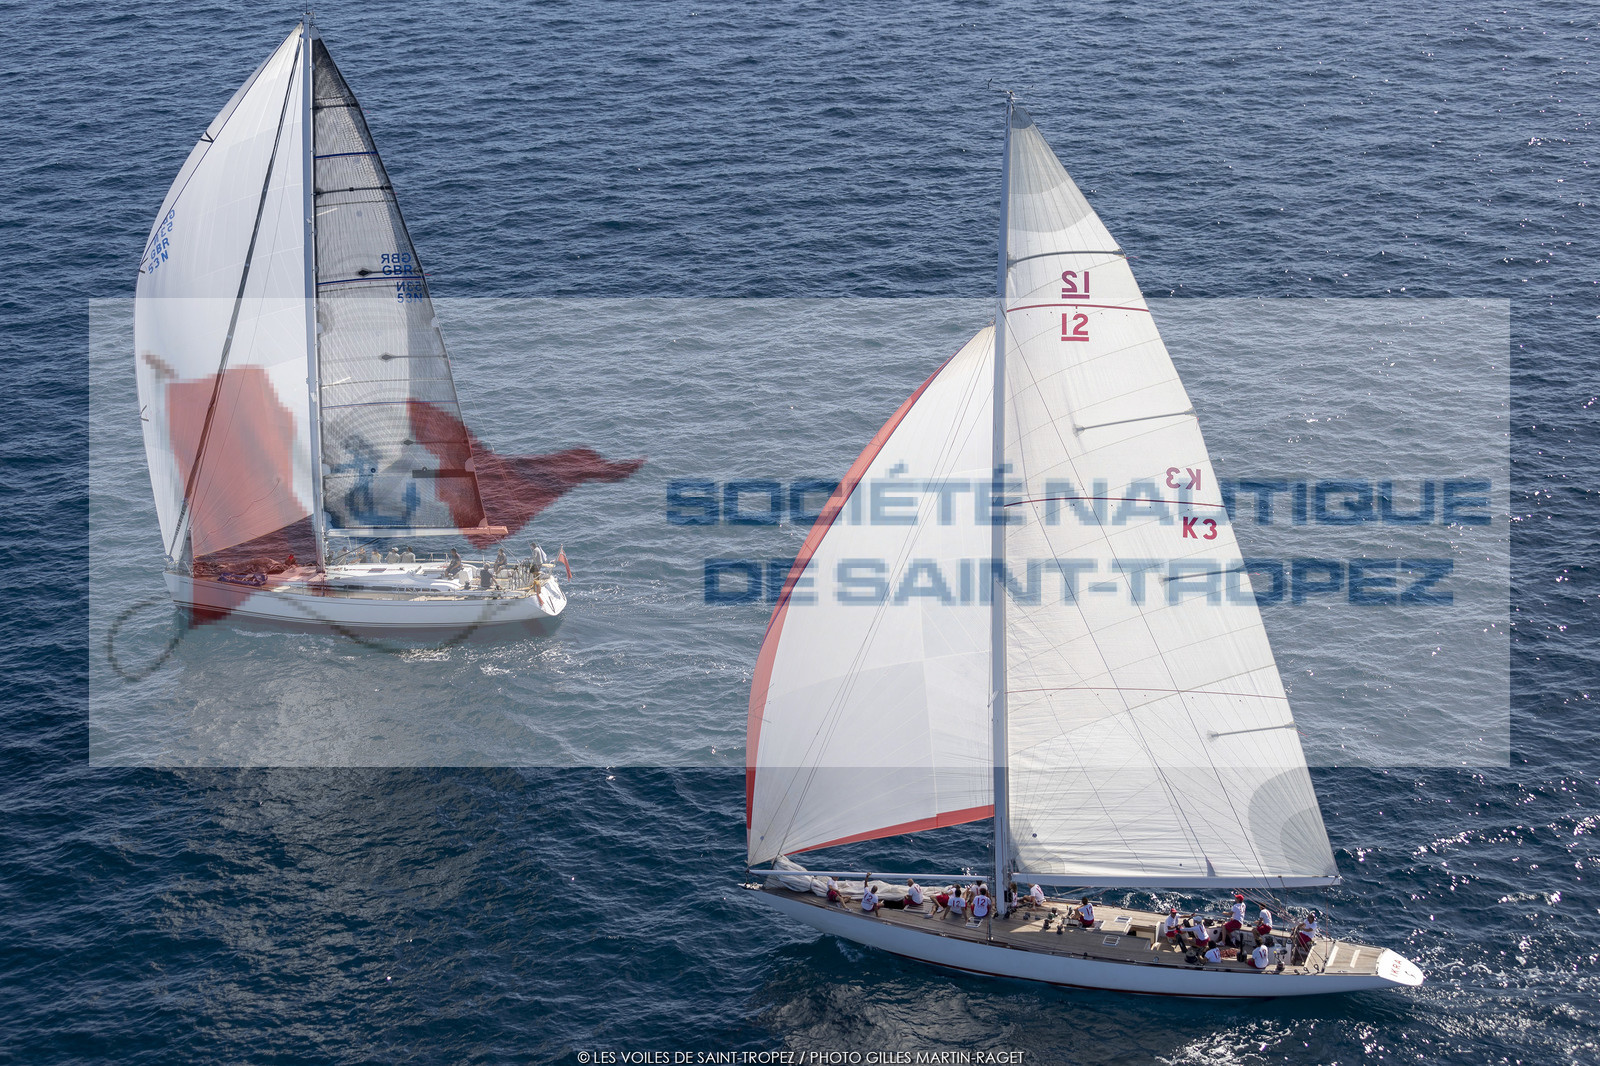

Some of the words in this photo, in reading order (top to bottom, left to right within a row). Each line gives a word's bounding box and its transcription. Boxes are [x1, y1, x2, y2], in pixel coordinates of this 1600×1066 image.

[151, 237, 170, 259] GBR
[382, 264, 413, 275] GBR
[397, 292, 423, 303] 53N
[1061, 312, 1089, 342] 12
[976, 897, 986, 907] 12
